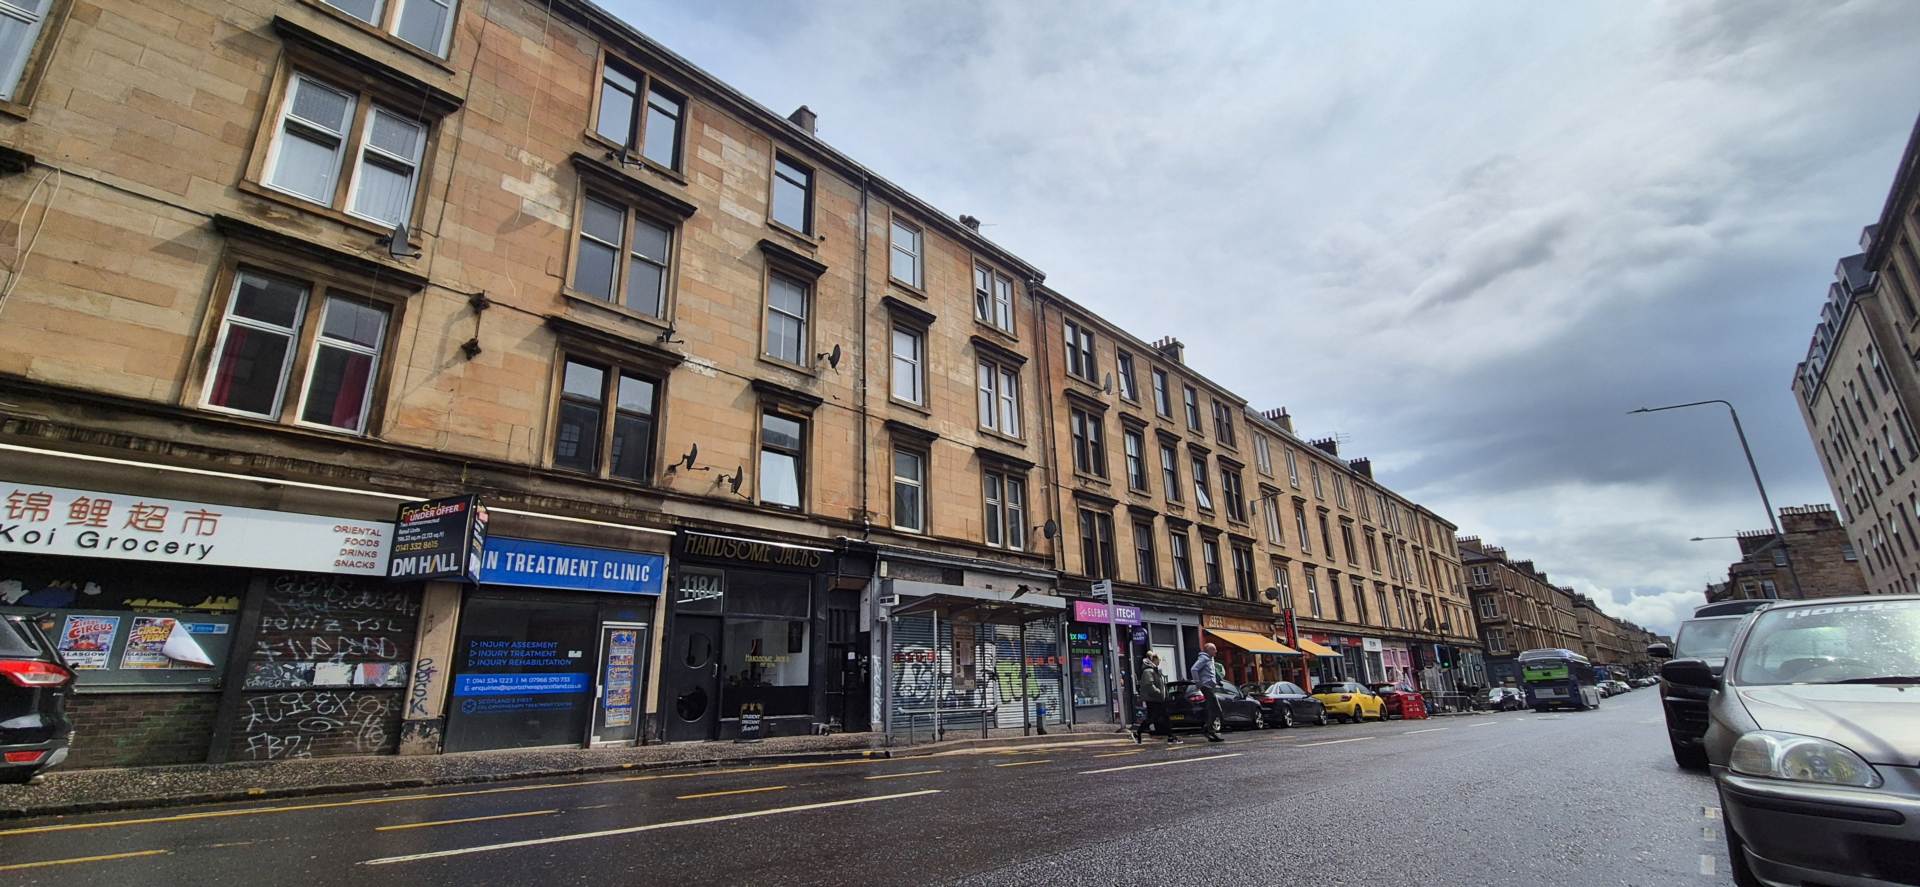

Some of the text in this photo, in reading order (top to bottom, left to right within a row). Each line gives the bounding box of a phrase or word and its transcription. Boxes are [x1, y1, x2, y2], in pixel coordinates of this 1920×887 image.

[6, 489, 222, 536] 锦鲤超市
[409, 504, 459, 521] UNDER OFFER
[333, 525, 382, 537] ORIENTAL
[0, 523, 214, 560] Koi Grocery
[344, 537, 380, 547] FOODS
[340, 548, 378, 558] DRINKS
[684, 535, 821, 568] HANDSOME JACKS
[334, 559, 376, 569] SNACKS
[391, 553, 458, 577] DM HALL
[506, 552, 599, 578] TREATMENT
[603, 561, 650, 582] CLINIC
[682, 576, 719, 600] 1184
[1116, 607, 1136, 619] ITECH
[68, 624, 113, 640] CIRCUS
